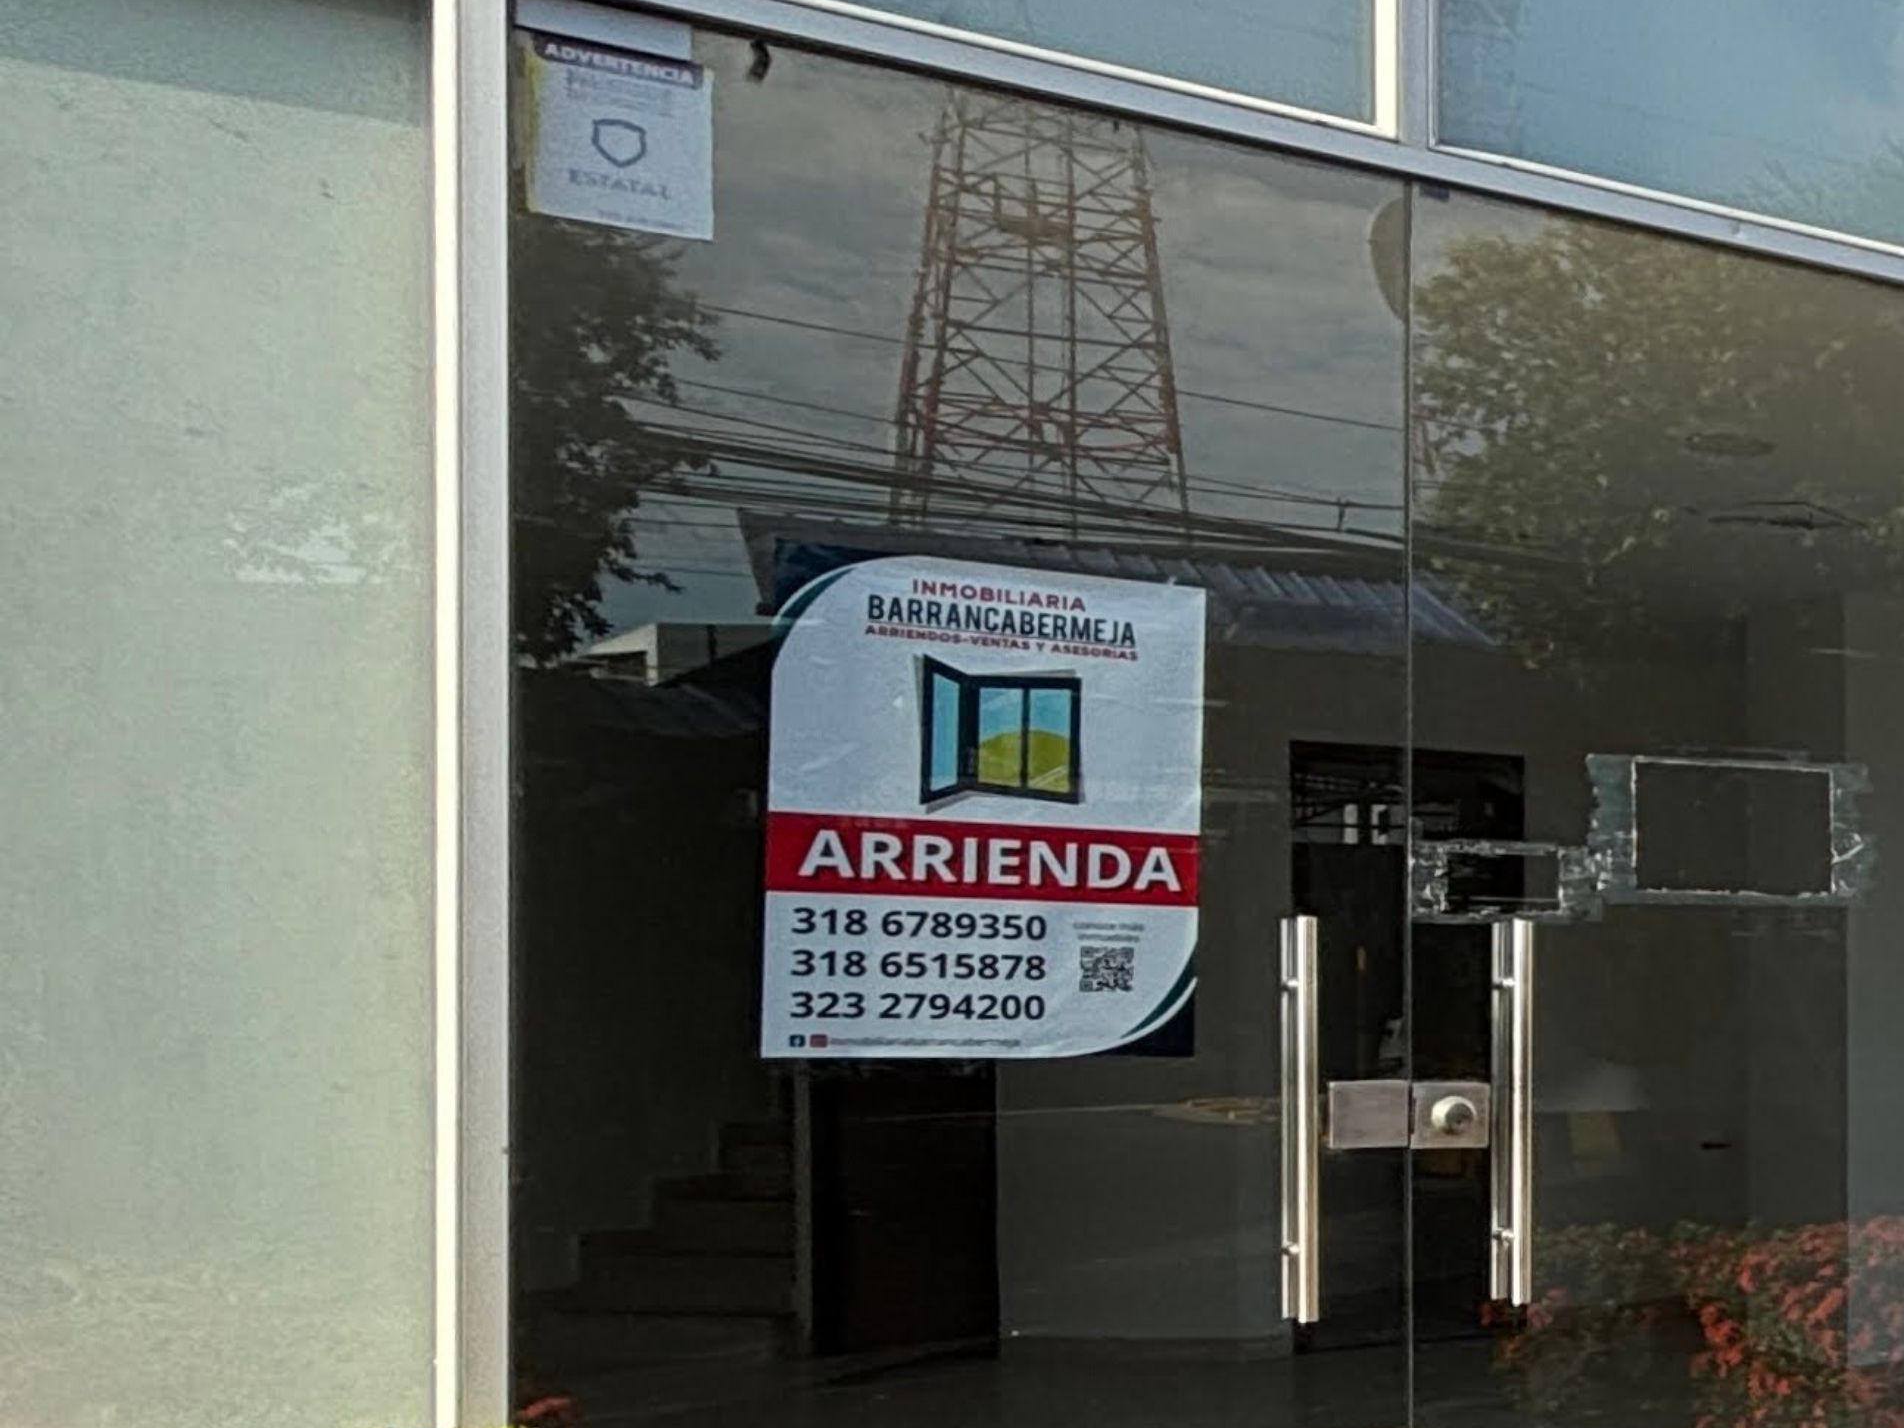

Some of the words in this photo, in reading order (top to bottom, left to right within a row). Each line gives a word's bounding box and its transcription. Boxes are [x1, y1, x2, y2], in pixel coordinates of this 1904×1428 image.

[911, 578, 1087, 613] INMOBILIARIA
[867, 593, 1137, 647] BARRANCABERMEJA
[1036, 640, 1045, 653] Y
[1051, 643, 1139, 662] ASESORIAS
[798, 829, 1182, 892] ARRIENDA
[791, 907, 868, 936] 318
[881, 910, 1047, 941] 6789350
[790, 949, 867, 977] 318
[880, 951, 1046, 981] 6515878
[790, 991, 866, 1019] 323
[878, 992, 1046, 1020] 2794200
